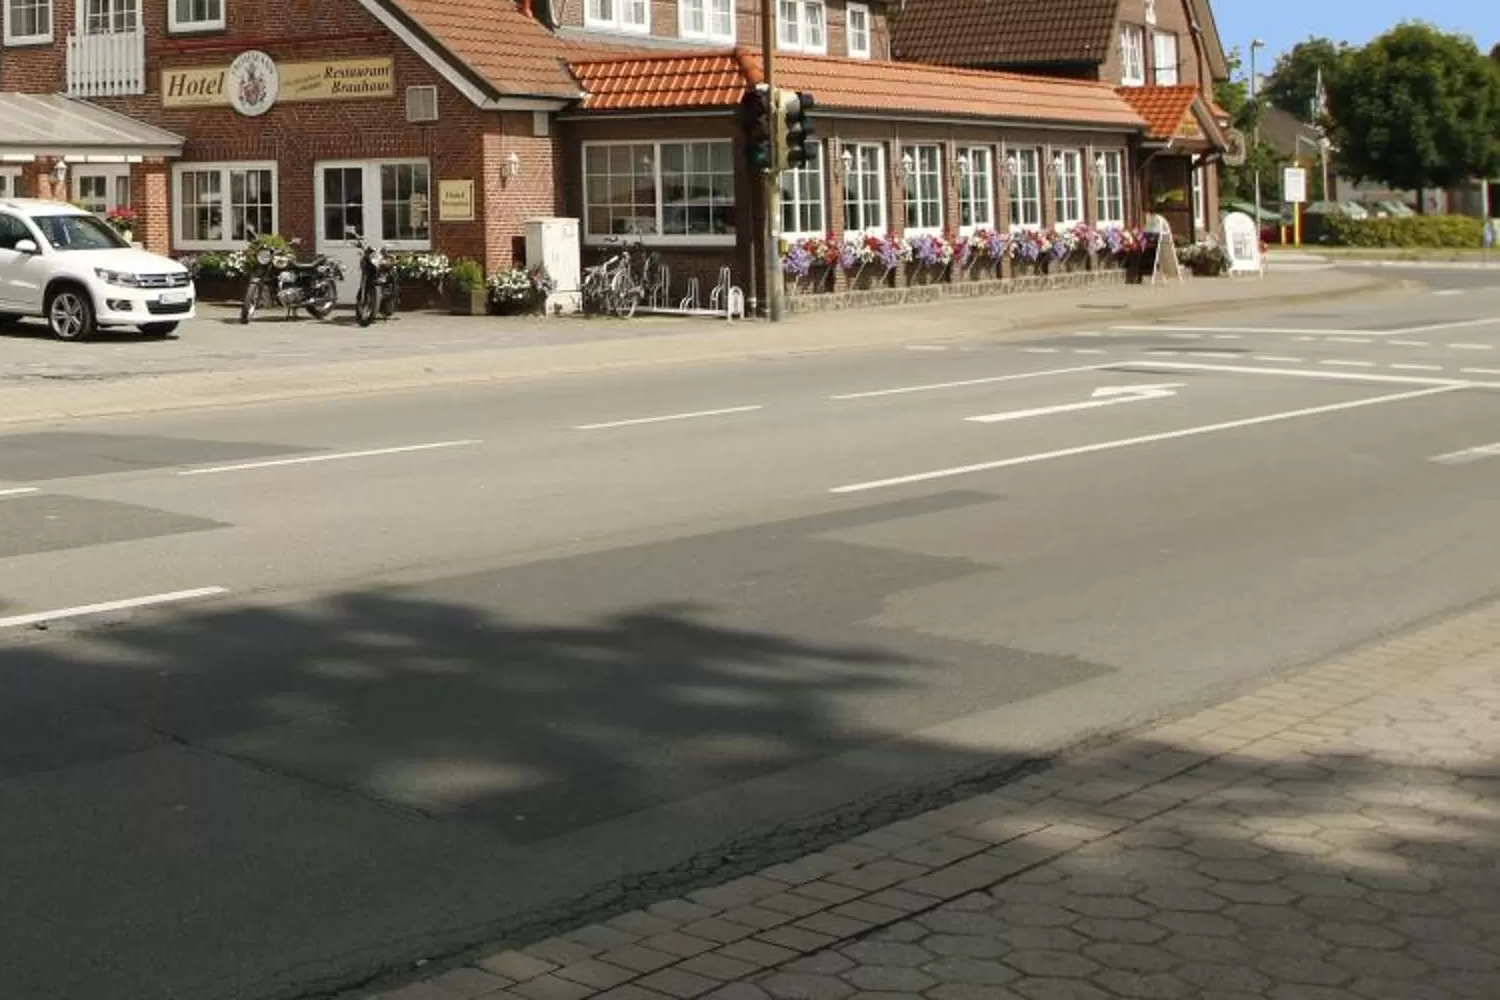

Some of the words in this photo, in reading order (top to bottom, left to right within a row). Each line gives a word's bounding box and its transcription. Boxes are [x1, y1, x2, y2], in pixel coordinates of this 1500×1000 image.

[324, 65, 389, 79] Restaurant
[168, 71, 224, 97] Hotel
[331, 80, 389, 94] Brauhaus
